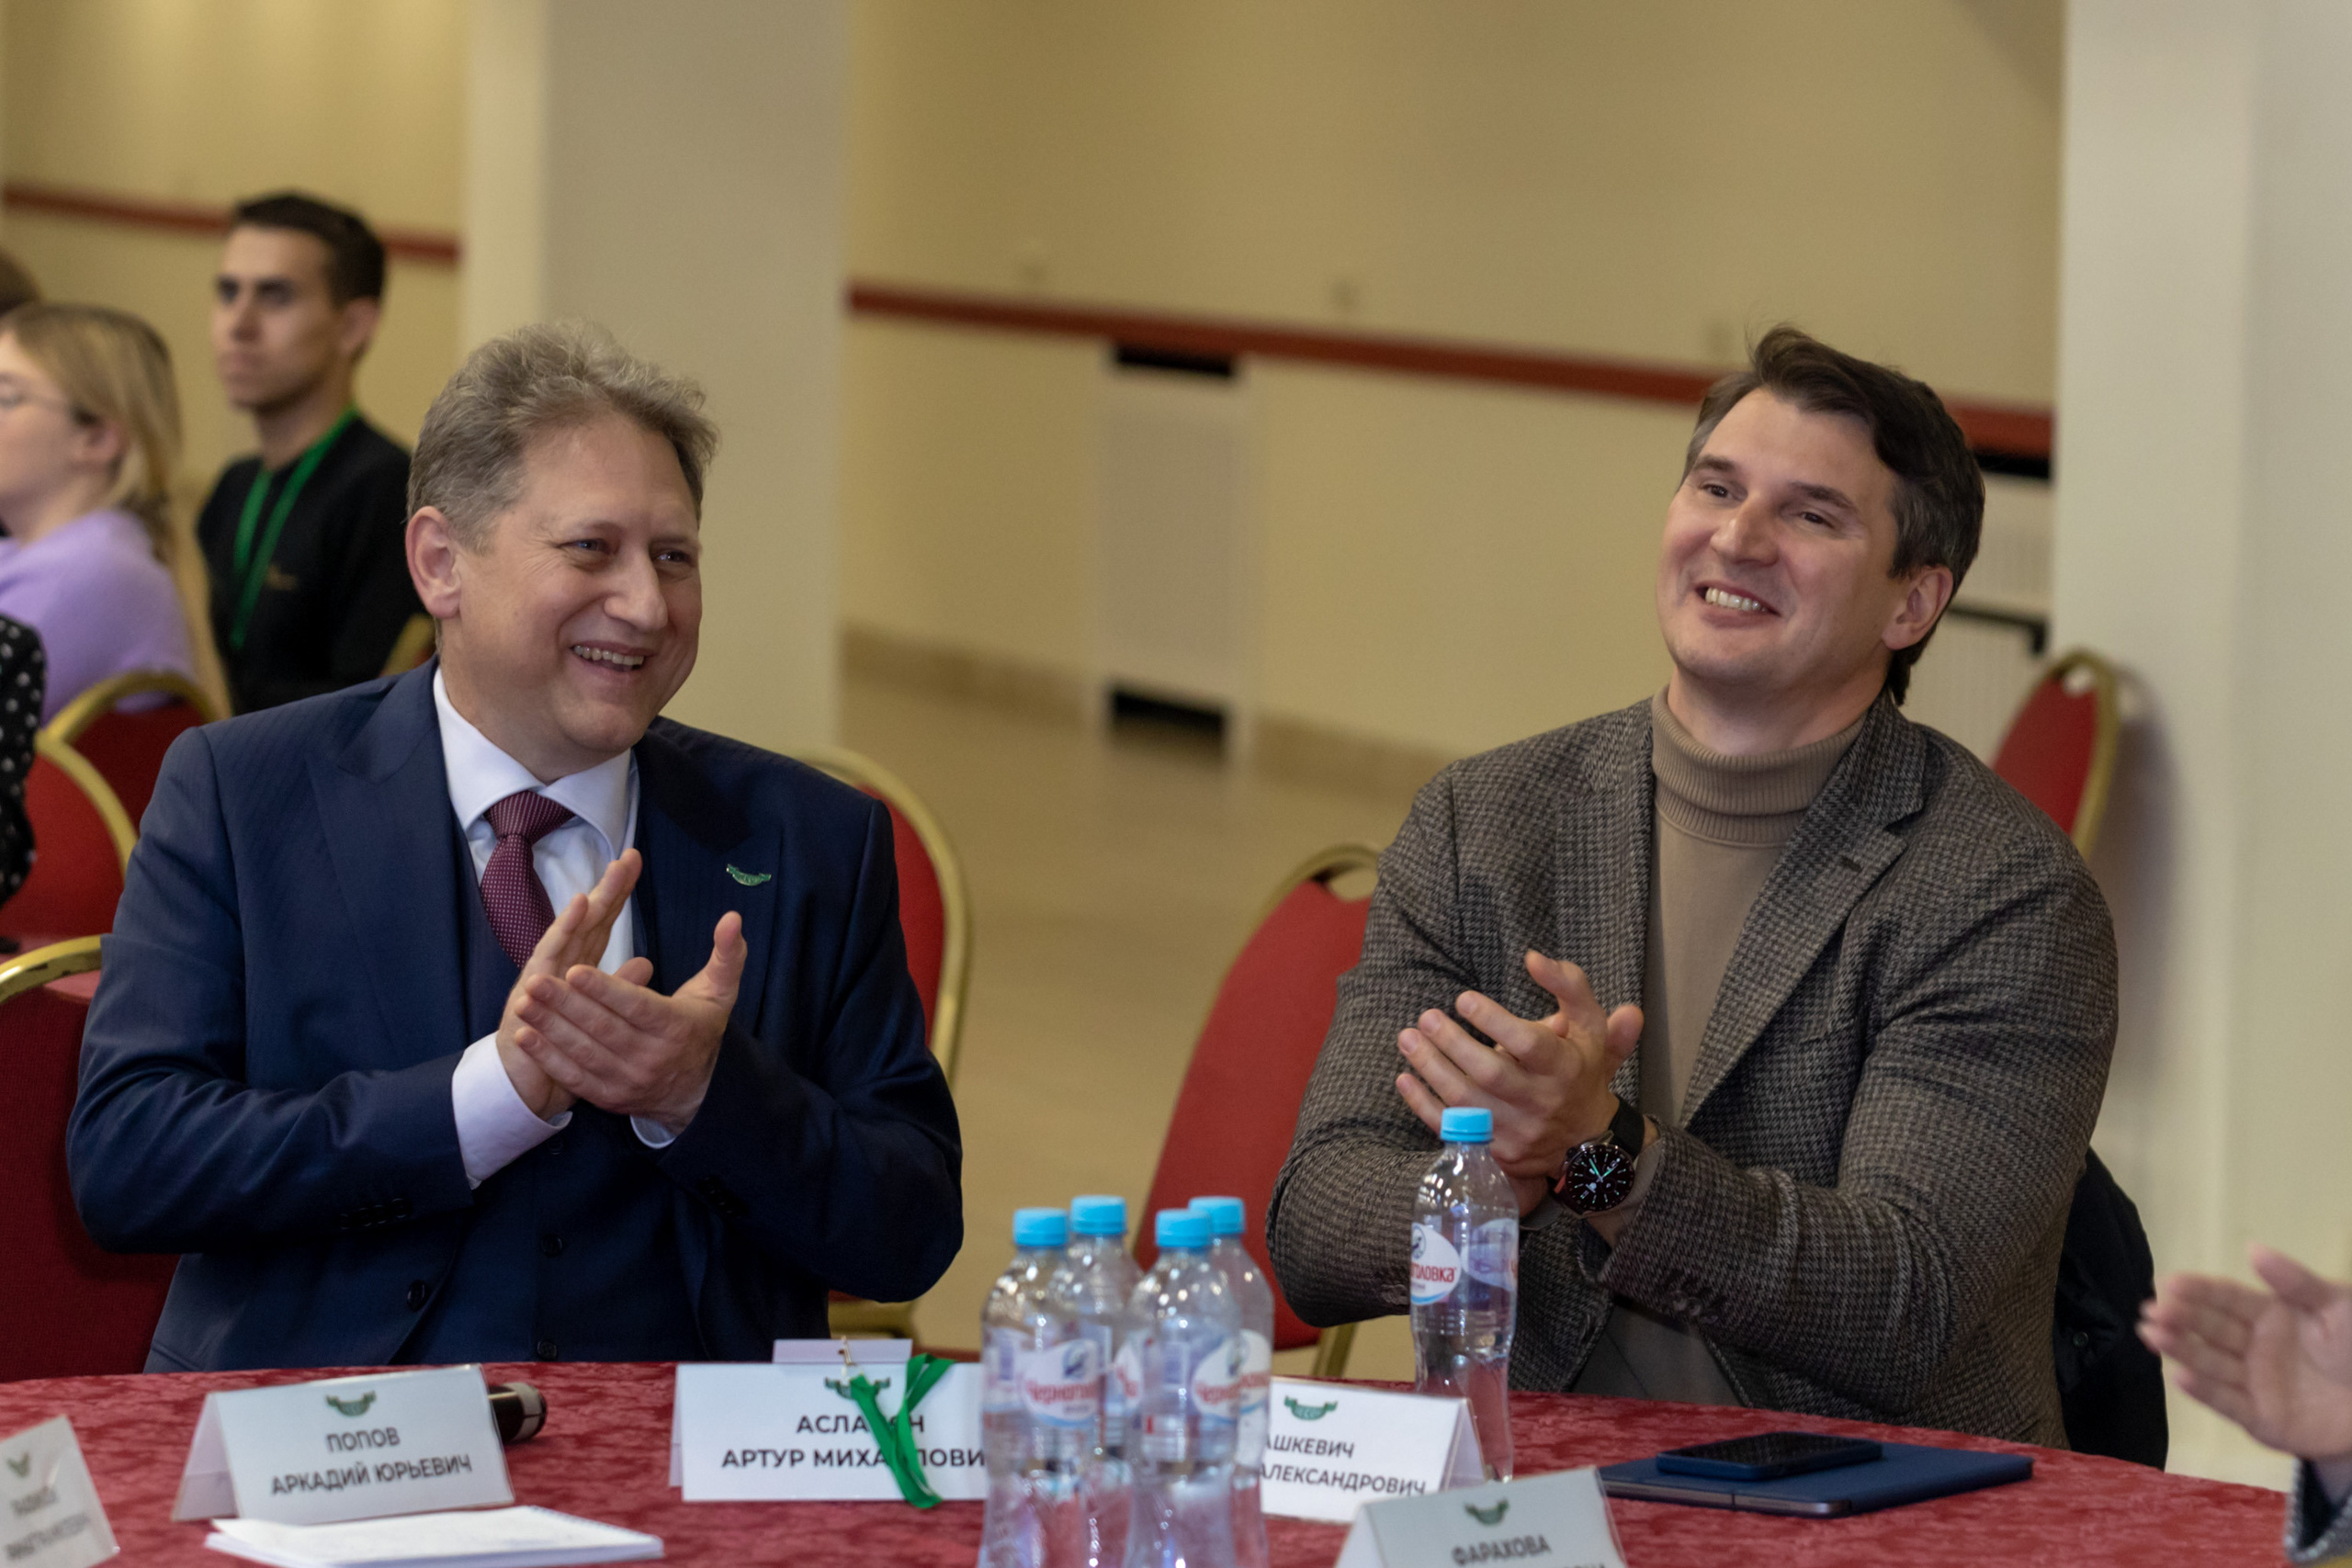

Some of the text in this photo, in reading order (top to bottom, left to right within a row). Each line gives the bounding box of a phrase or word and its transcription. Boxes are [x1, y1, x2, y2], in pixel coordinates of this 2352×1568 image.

[797, 1415, 924, 1433] АСЛАН
[326, 1427, 401, 1452] ПОПОВ
[721, 1449, 986, 1467] АРТУР МИХАЛОВИ
[271, 1453, 472, 1495] АРКАДИЙ ЮРЬЕВИЧ
[1452, 1534, 1552, 1566] ФАРАХОВА
